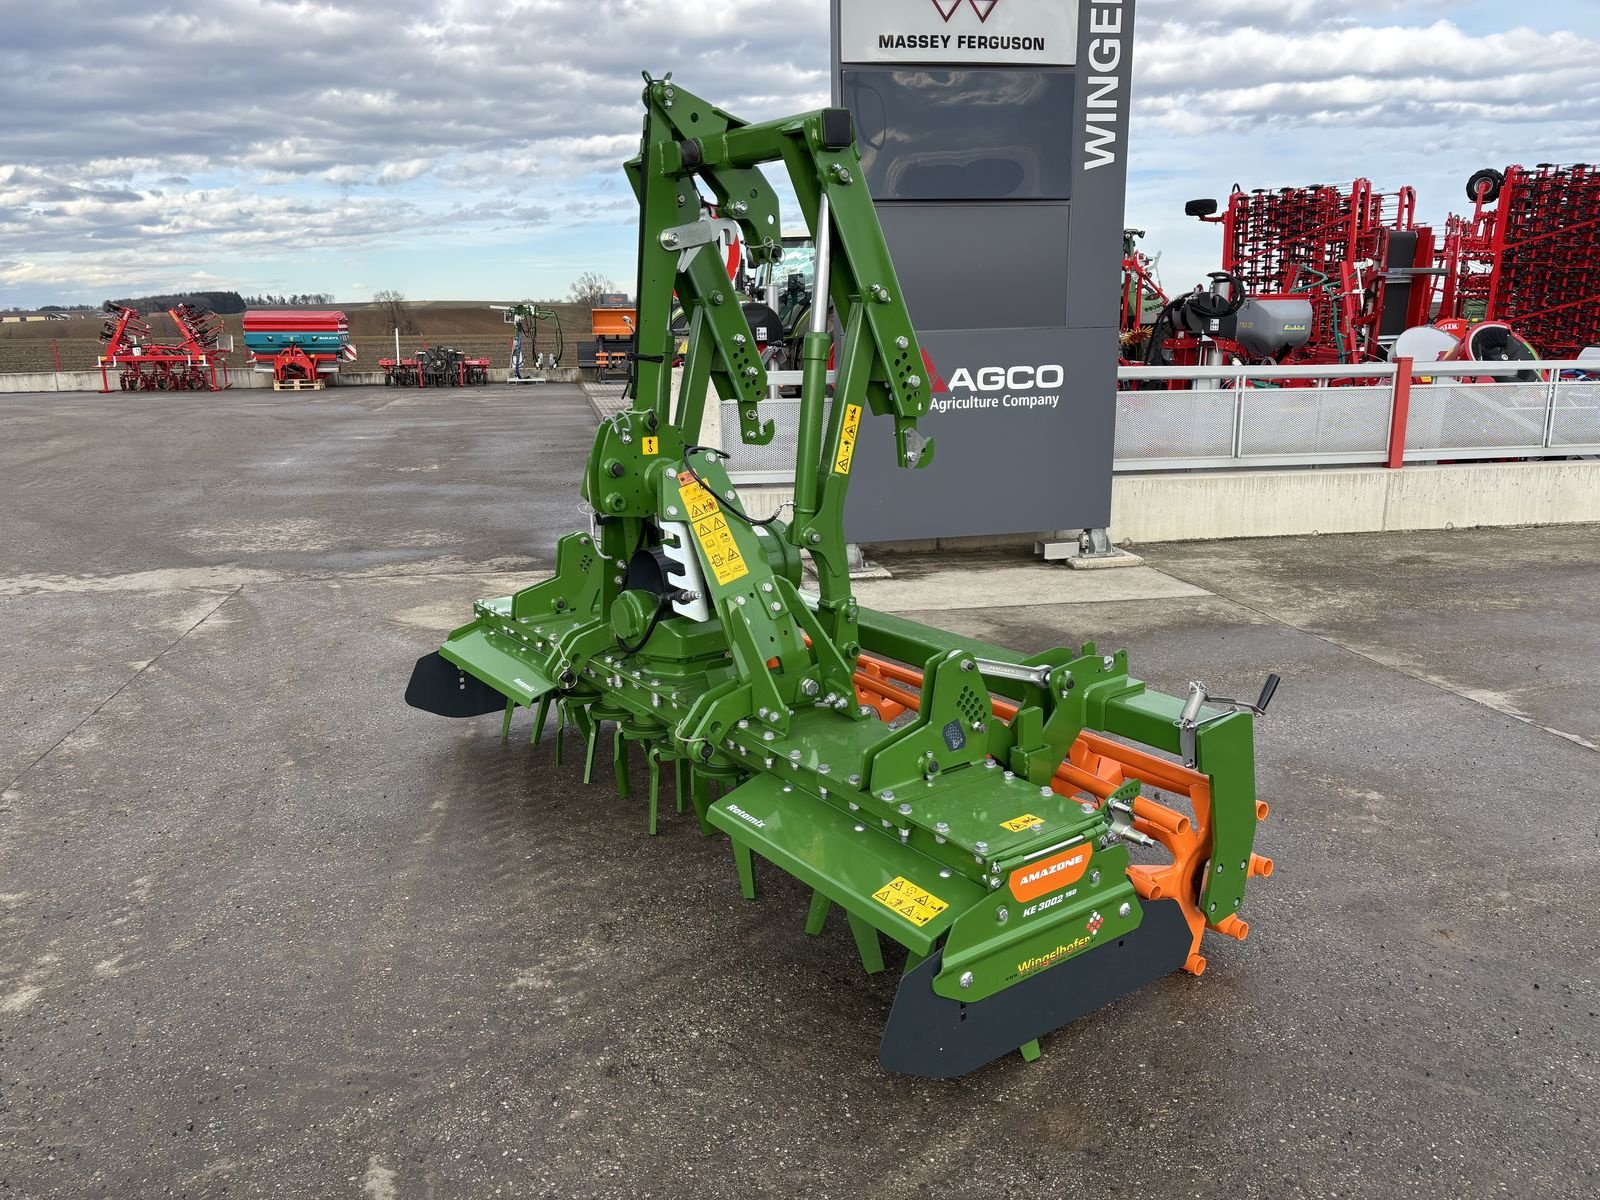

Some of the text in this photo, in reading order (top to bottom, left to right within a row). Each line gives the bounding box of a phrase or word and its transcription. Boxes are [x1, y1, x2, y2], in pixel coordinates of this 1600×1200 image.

[878, 34, 1045, 51] MASSEY FERGUSON
[1083, 0, 1122, 170] WINGE
[948, 364, 1064, 392] AGCO
[930, 394, 1060, 413] Agriculture Company
[726, 804, 766, 828] Rotamix
[1020, 854, 1084, 886] AMAZONE
[1023, 905, 1038, 918] KE
[1037, 894, 1064, 911] 3002
[1018, 936, 1091, 975] Wingelhofer
